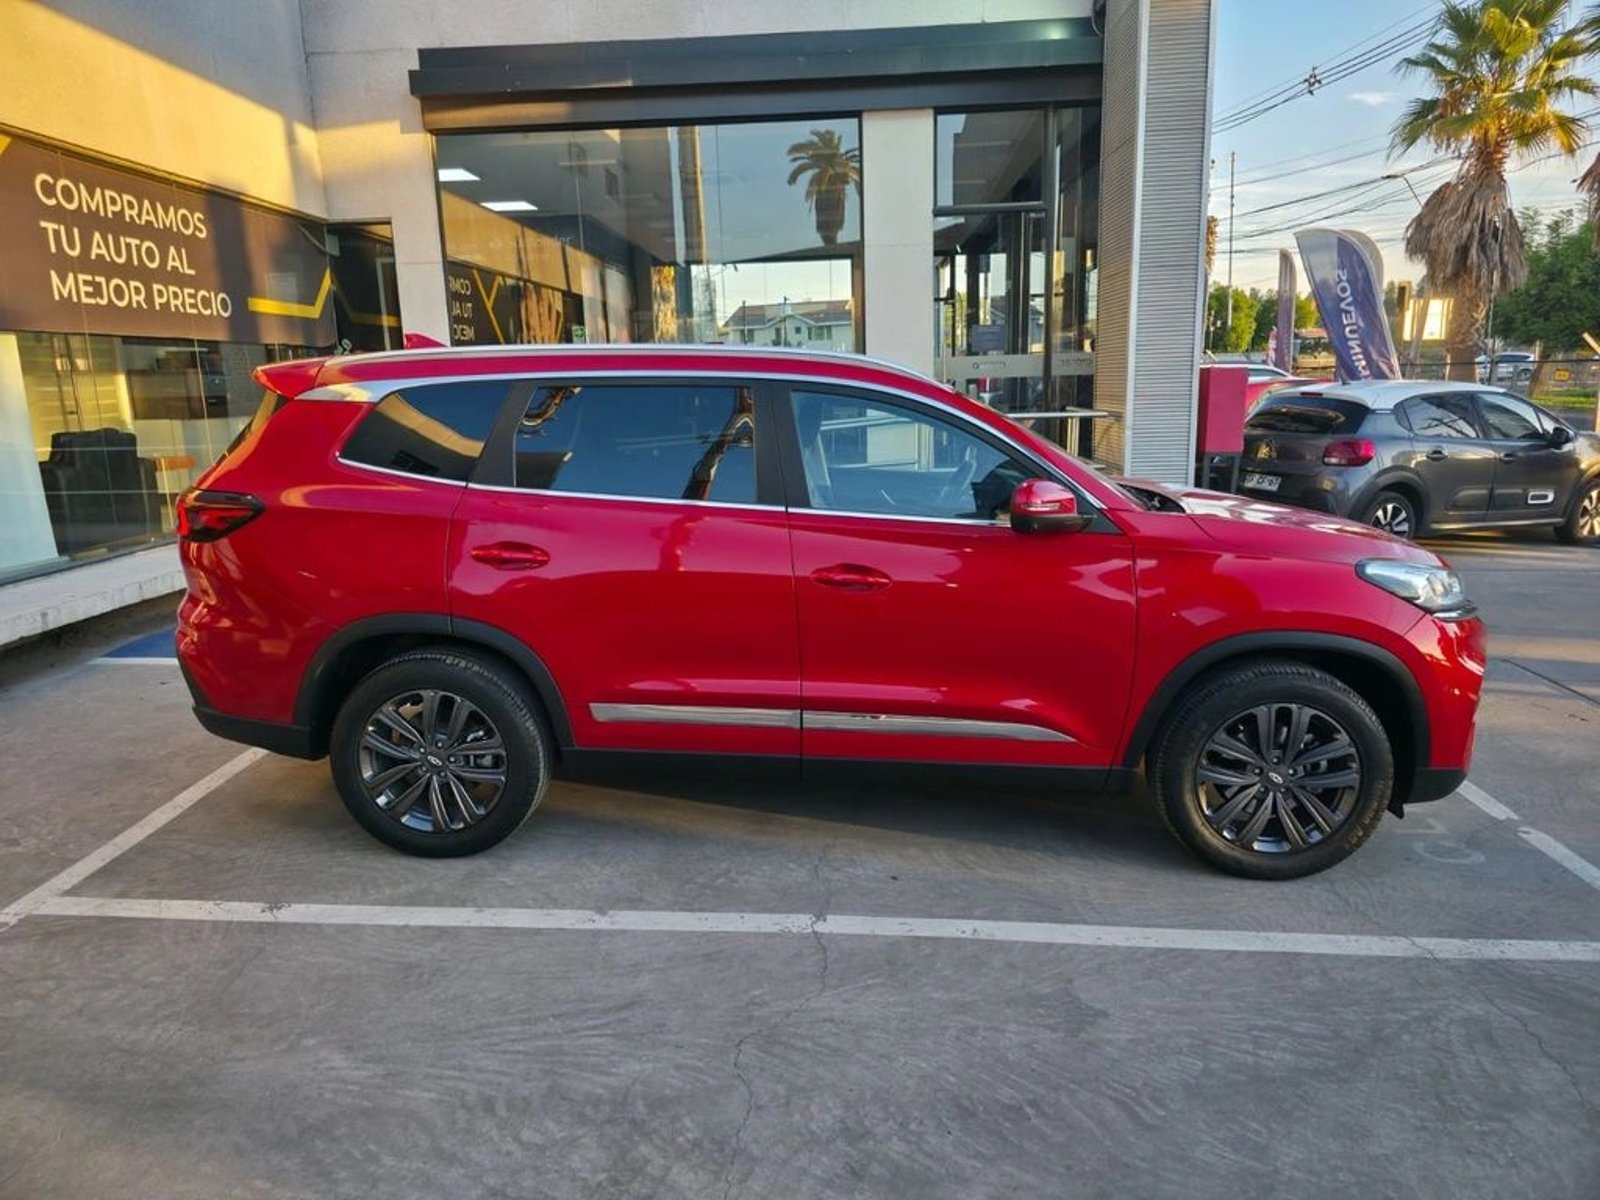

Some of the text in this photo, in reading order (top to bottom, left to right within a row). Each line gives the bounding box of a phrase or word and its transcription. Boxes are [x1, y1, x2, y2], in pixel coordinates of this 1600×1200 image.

[35, 174, 207, 238] COMPRAMOS
[39, 220, 196, 276] TU AUTO AL
[50, 269, 232, 318] MEJOR PRECIO
